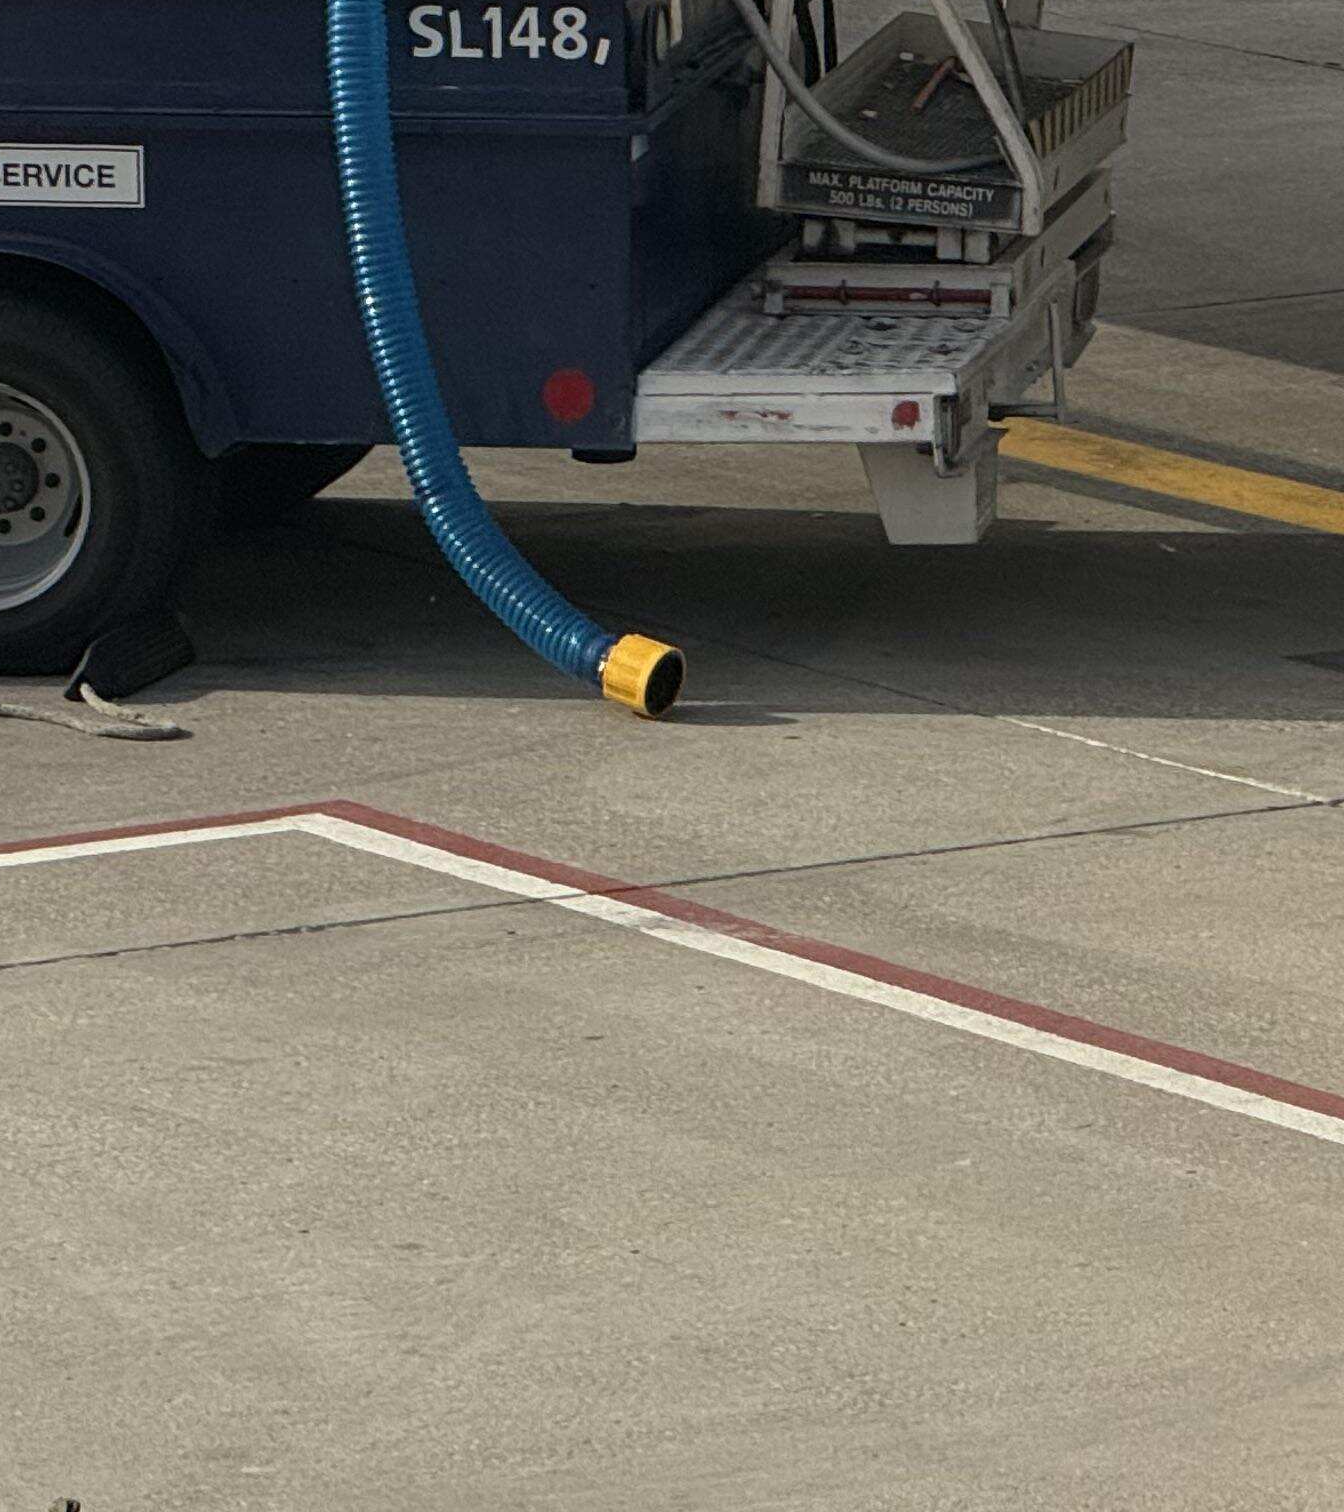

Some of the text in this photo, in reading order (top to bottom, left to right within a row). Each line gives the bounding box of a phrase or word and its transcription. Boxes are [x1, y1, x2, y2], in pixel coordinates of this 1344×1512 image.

[809, 171, 995, 202] MAX. PLATFORM CAPACITY
[829, 190, 854, 205] 500
[908, 198, 974, 217] PERSONS)
